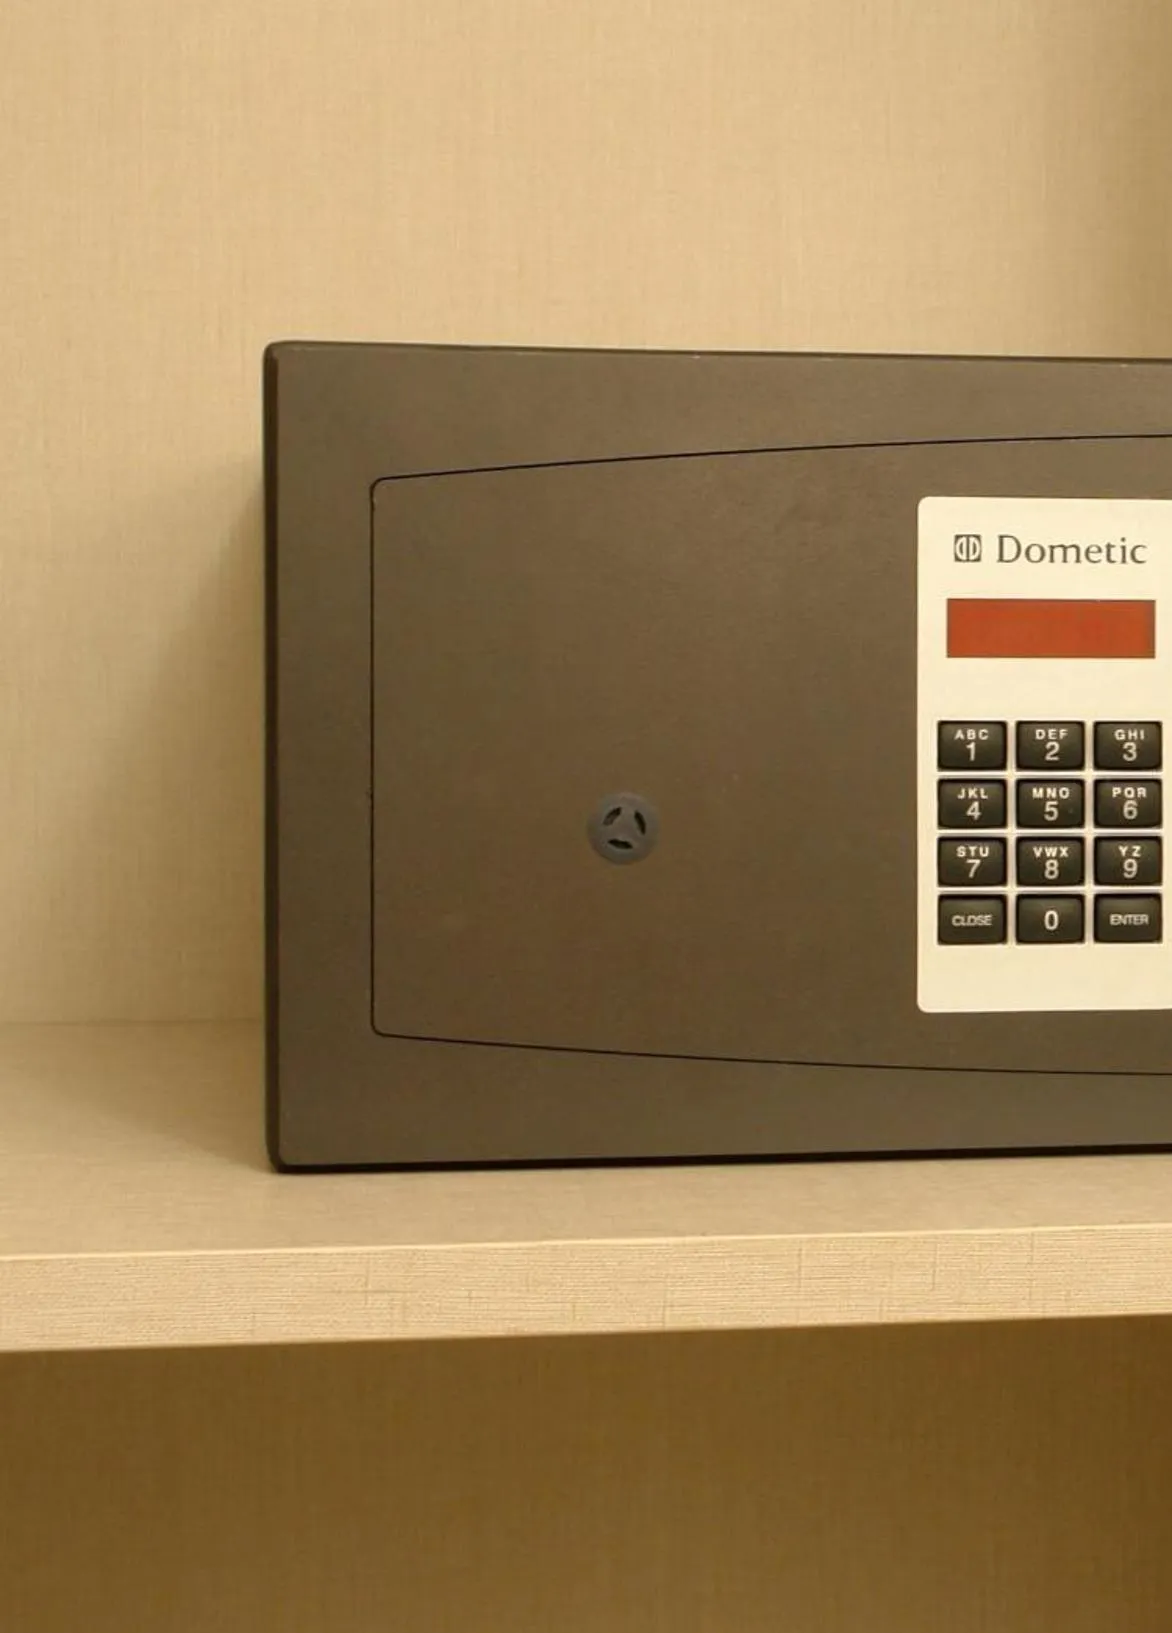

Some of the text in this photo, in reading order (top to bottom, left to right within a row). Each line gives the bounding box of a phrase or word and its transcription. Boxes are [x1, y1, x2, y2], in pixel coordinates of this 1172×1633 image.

[997, 534, 1148, 564] Dometic
[954, 729, 989, 740] ABC
[1035, 729, 1068, 740] DEF
[1114, 729, 1145, 740] GHI
[966, 742, 976, 761] 1
[1045, 742, 1059, 761] 2
[1123, 743, 1137, 761] 3
[957, 788, 988, 799] JKL
[1032, 788, 1070, 799] MNO
[1112, 787, 1147, 798] PQR
[966, 802, 981, 820] 4
[1044, 801, 1058, 821] 5
[1123, 801, 1138, 819] 6
[956, 846, 989, 857] STU
[1033, 847, 1069, 857] VWX
[966, 860, 981, 878] 7
[1044, 859, 1059, 879] 8
[1123, 859, 1137, 878] 9
[952, 915, 993, 926] CLOSE
[1044, 911, 1058, 930] 0
[1110, 914, 1149, 925] ENTER
